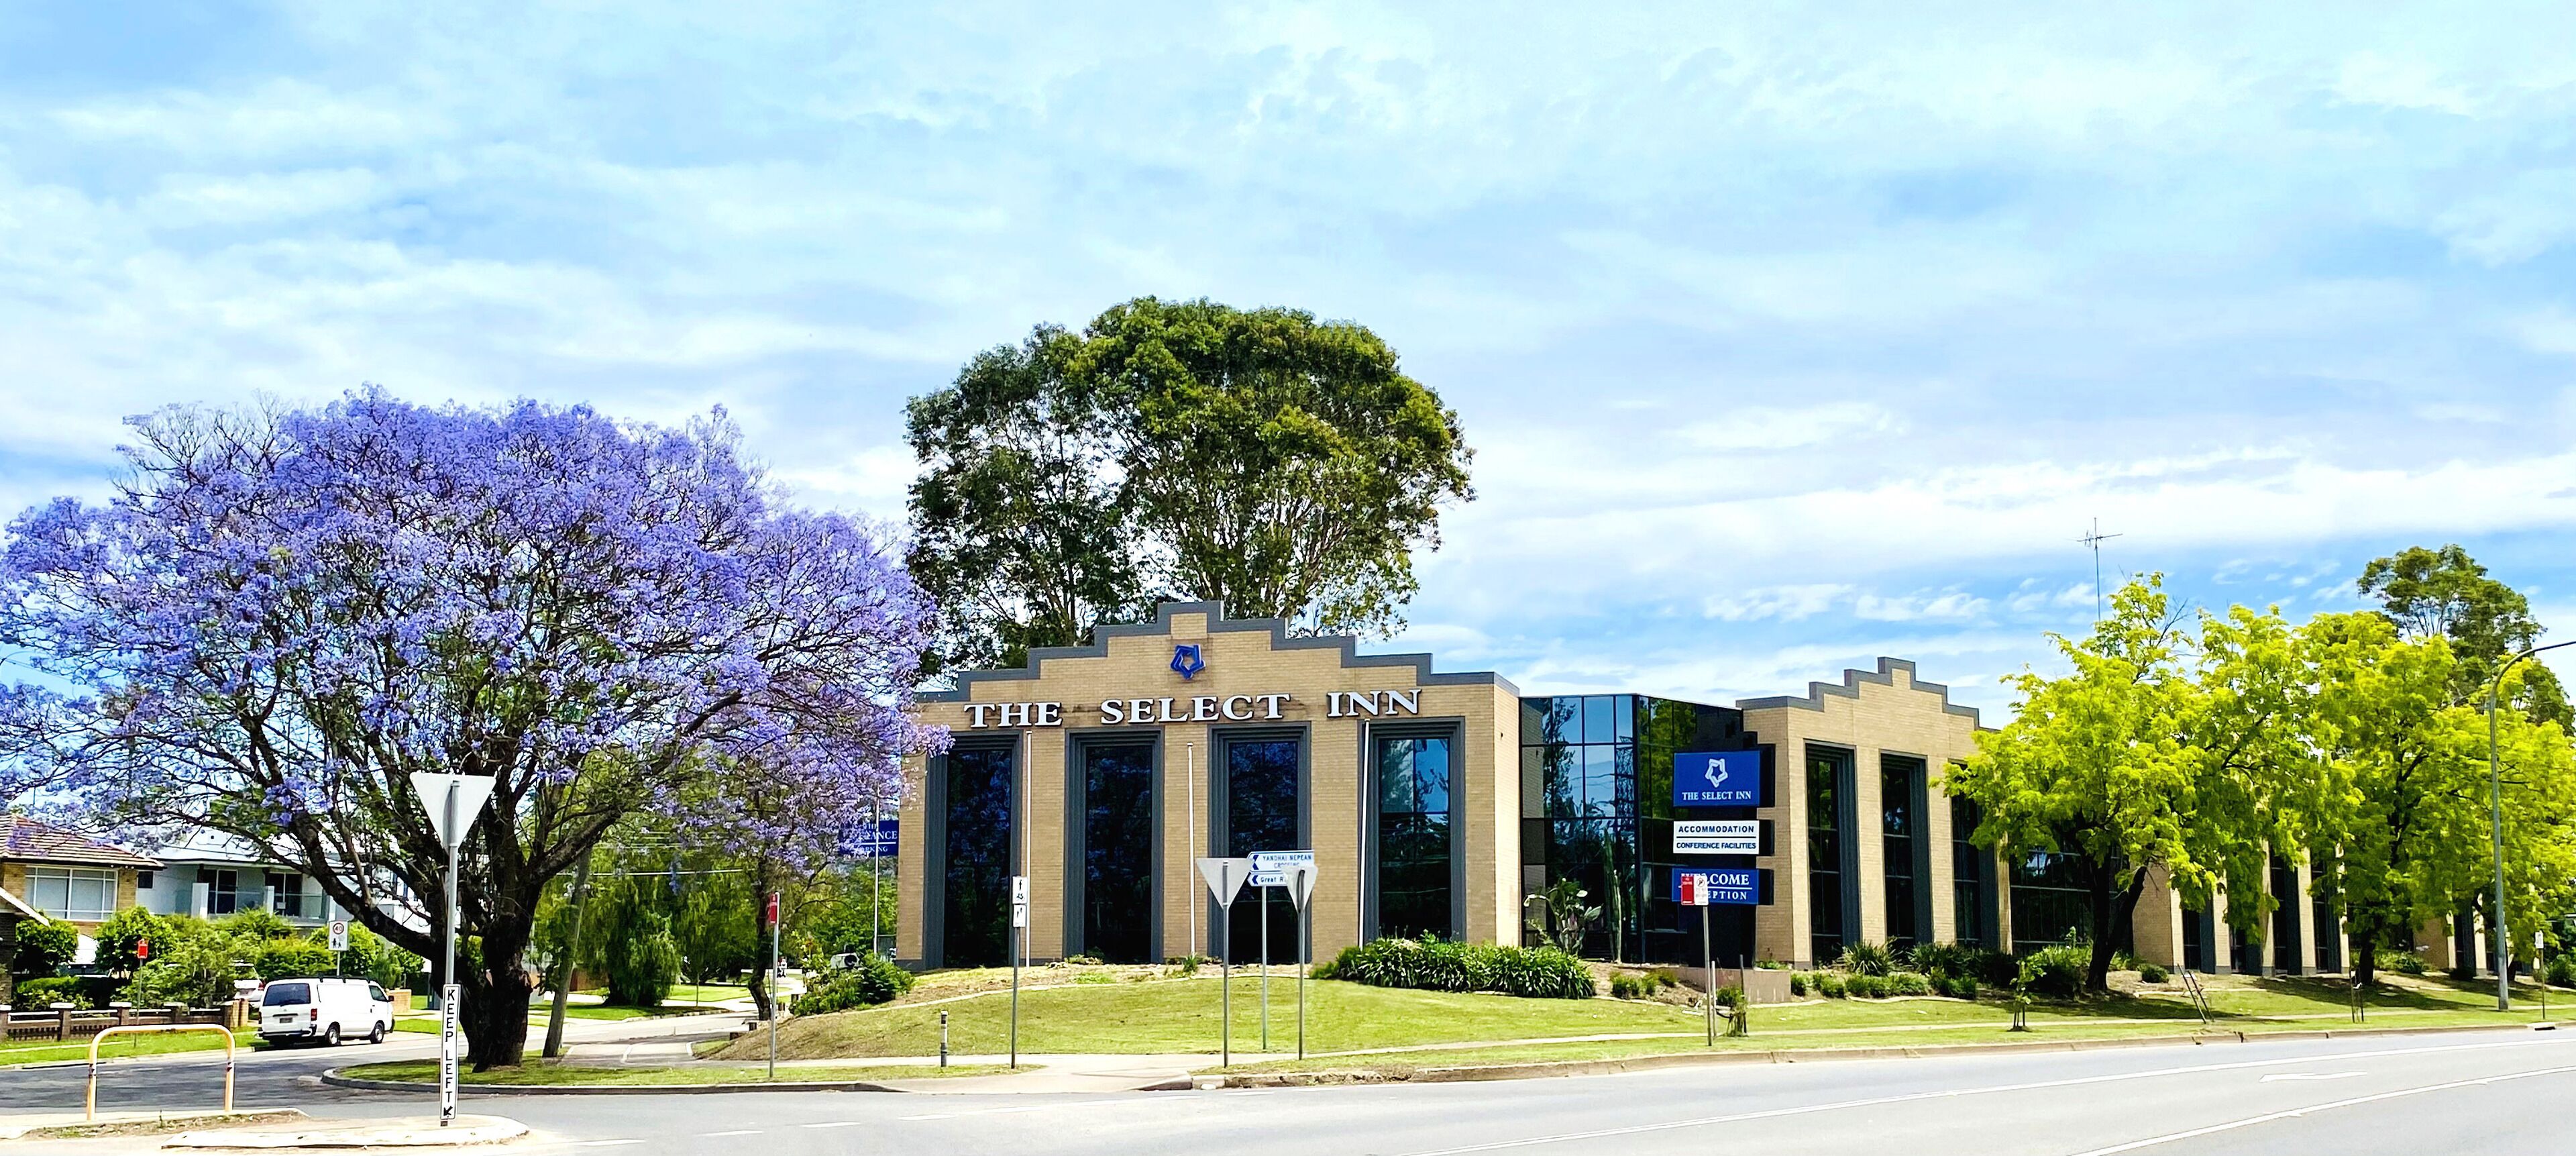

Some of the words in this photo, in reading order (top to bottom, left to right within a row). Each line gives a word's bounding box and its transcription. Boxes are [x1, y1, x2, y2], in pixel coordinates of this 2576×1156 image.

[964, 701, 1063, 728] THE
[1100, 693, 1291, 725] SELECT
[1327, 688, 1422, 717] INN
[1682, 792, 1699, 800] THE
[1701, 791, 1733, 800] SELECT
[1735, 790, 1752, 800] INN
[445, 990, 455, 1042] KEEP
